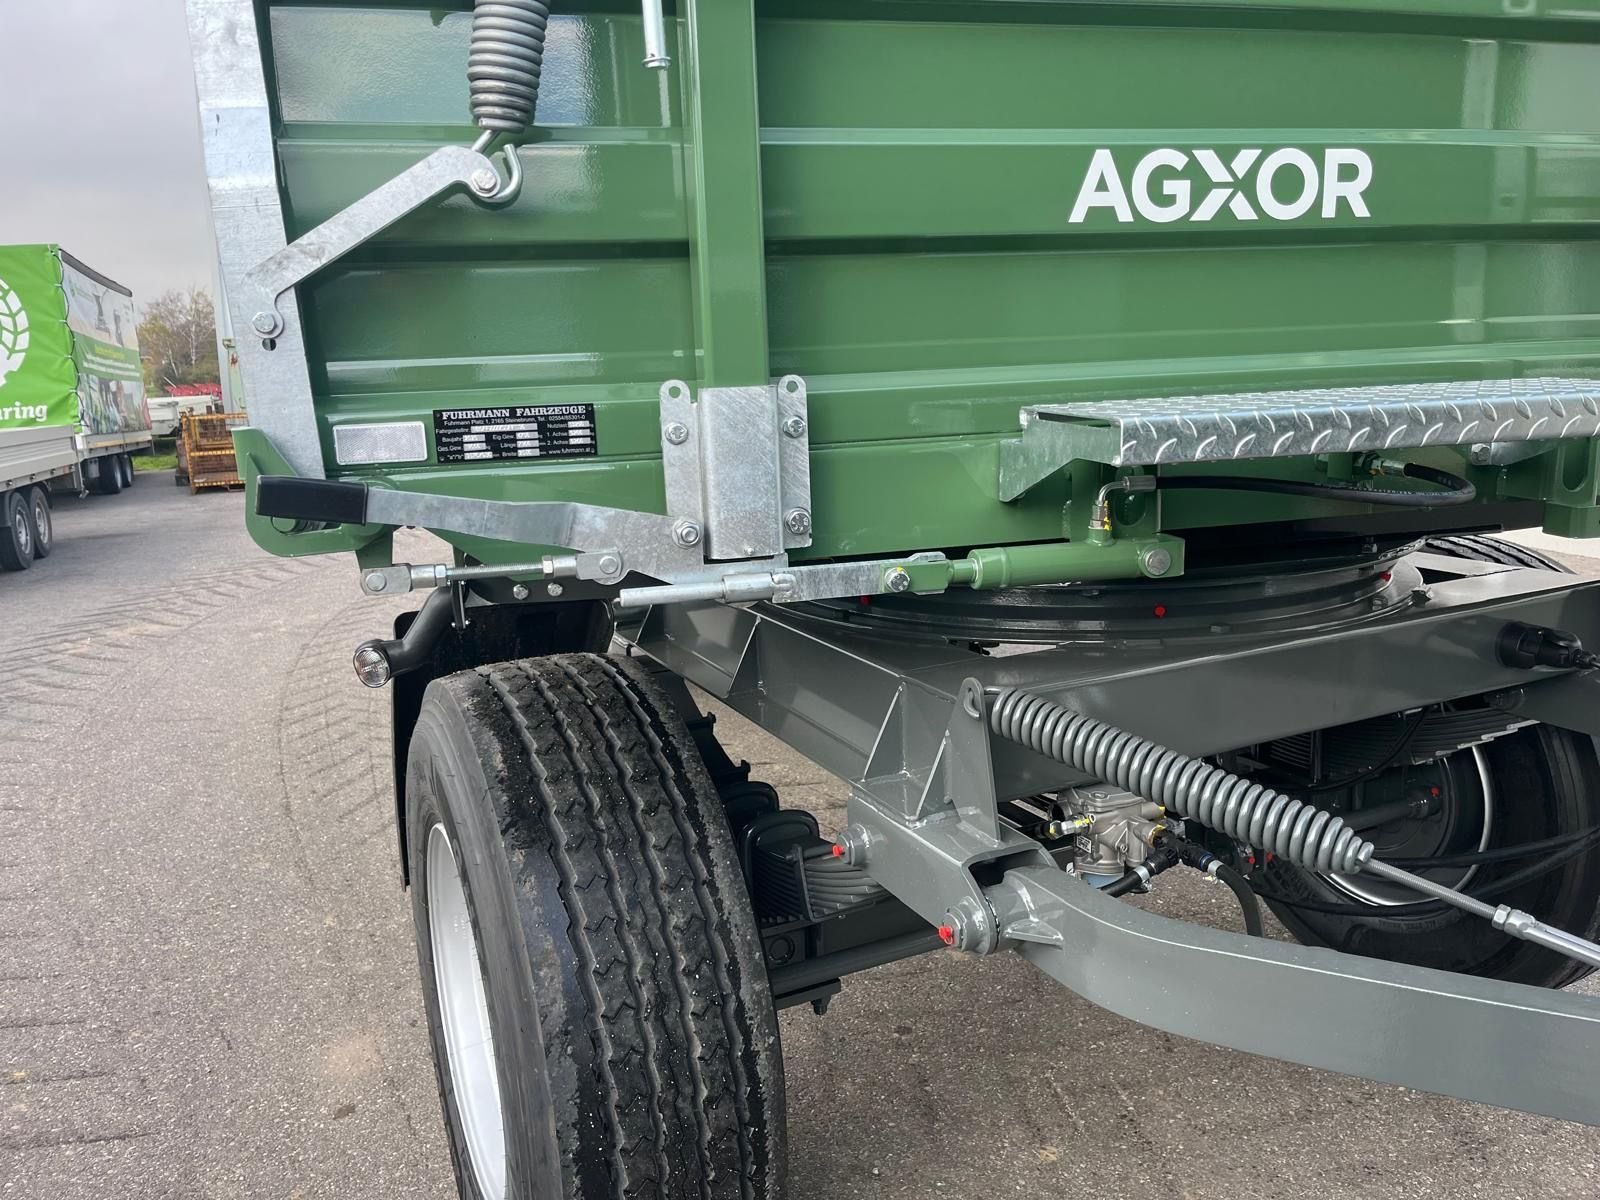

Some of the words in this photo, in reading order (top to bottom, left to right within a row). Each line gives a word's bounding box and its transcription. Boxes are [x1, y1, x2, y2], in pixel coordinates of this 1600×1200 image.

[1068, 148, 1373, 223] AGXOR
[0, 401, 47, 421] ring
[442, 409, 510, 420] FUHRMANN
[516, 405, 586, 416] FAHRZEUGE
